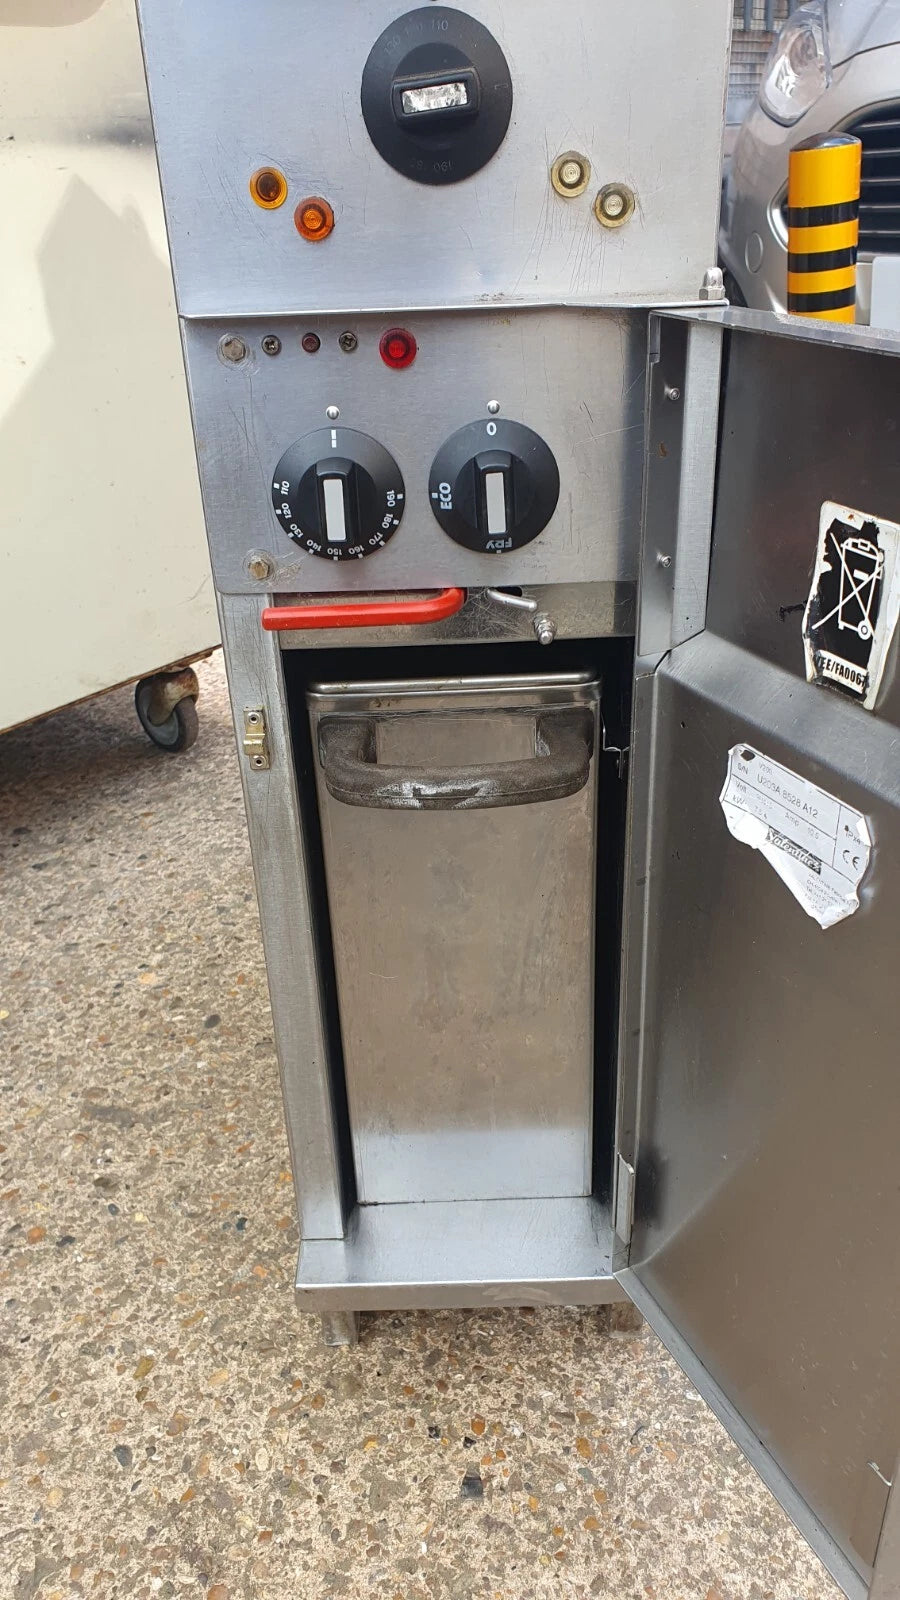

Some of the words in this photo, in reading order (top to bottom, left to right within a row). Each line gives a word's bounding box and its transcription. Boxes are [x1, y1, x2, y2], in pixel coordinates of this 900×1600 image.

[486, 422, 497, 436] 0
[281, 481, 290, 495] 110
[386, 490, 396, 507] 190
[439, 482, 452, 510] ECO
[281, 503, 291, 519] 120
[382, 513, 393, 529] 180
[290, 523, 304, 538] 130
[369, 531, 383, 545] 170
[485, 538, 513, 549] FRY
[306, 539, 322, 552] 140
[327, 547, 342, 556] 150
[348, 545, 365, 555] 160
[802, 803, 819, 819] A12
[842, 850, 860, 870] CE
